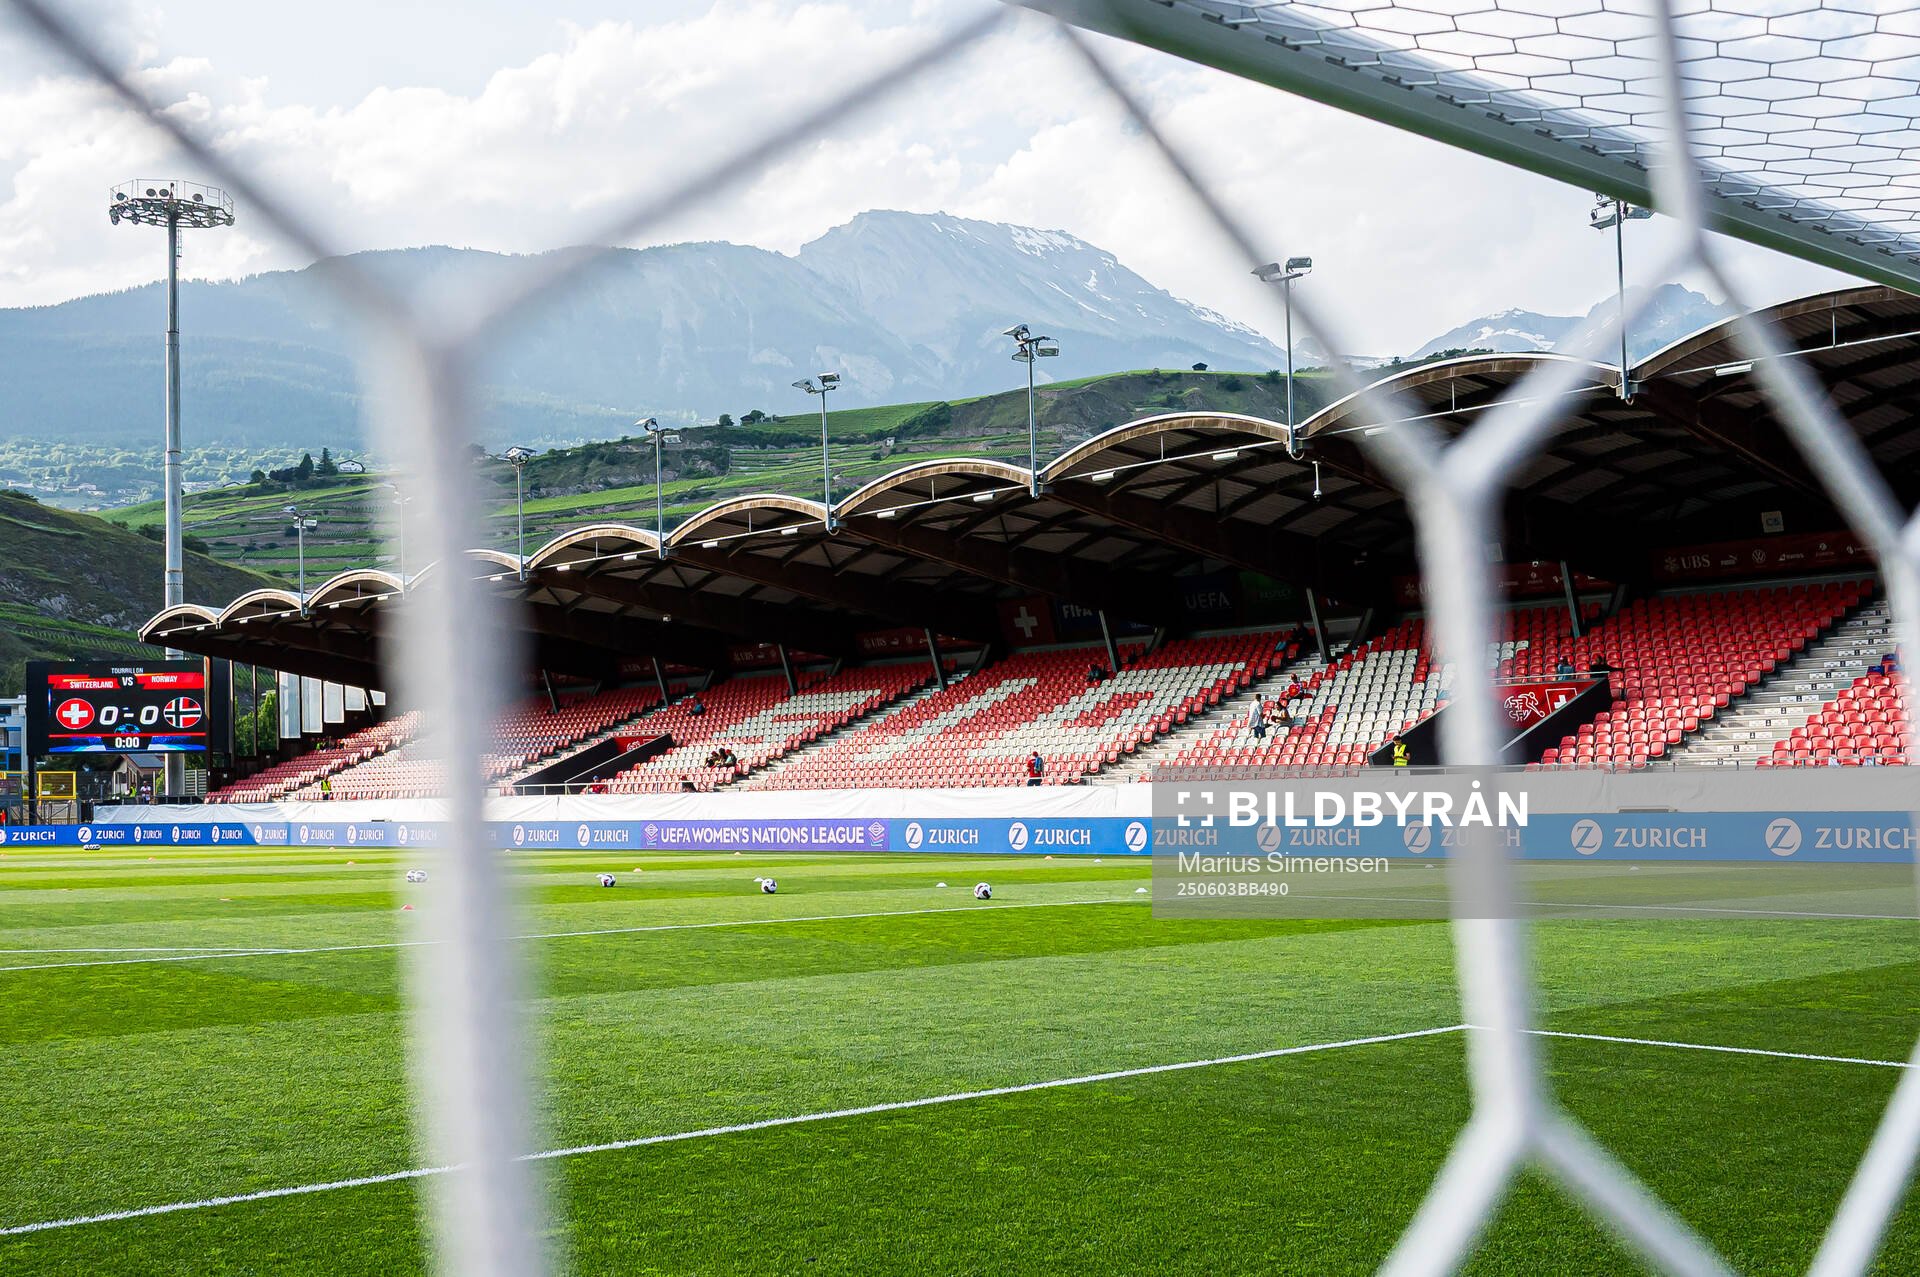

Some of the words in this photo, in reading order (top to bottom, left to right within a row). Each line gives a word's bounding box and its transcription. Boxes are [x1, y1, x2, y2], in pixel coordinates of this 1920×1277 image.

[1680, 554, 1711, 570] UBS
[1185, 592, 1230, 609] UEFA
[1062, 604, 1094, 619] FIFA
[69, 681, 114, 689] SWITZERLAND
[122, 676, 134, 687] VS
[151, 675, 178, 683] NORWAY
[115, 737, 140, 748] 0:00
[12, 831, 56, 841] ZURICH
[96, 830, 125, 839] ZURICH
[143, 829, 162, 839] ZURICH
[181, 829, 201, 839] ZURICH
[222, 829, 242, 840] ZURICH
[264, 829, 288, 840] ZURICH
[311, 829, 334, 840] ZURICH
[359, 829, 384, 841] ZURICH
[527, 830, 559, 842] ZURICH
[593, 829, 629, 843] ZURICH
[660, 826, 690, 844] UEFA
[691, 826, 750, 844] WOMEN'S
[753, 826, 809, 844] NATIONS
[812, 826, 864, 844] LEAGUE
[928, 829, 979, 845] ZURICH
[1034, 829, 1091, 845] ZURICH
[1154, 829, 1218, 845] ZURICH
[1289, 828, 1360, 846] ZURICH
[1440, 828, 1520, 847] ZUCH
[1613, 827, 1706, 848] ZURICH
[1814, 827, 1920, 849] ZURICH
